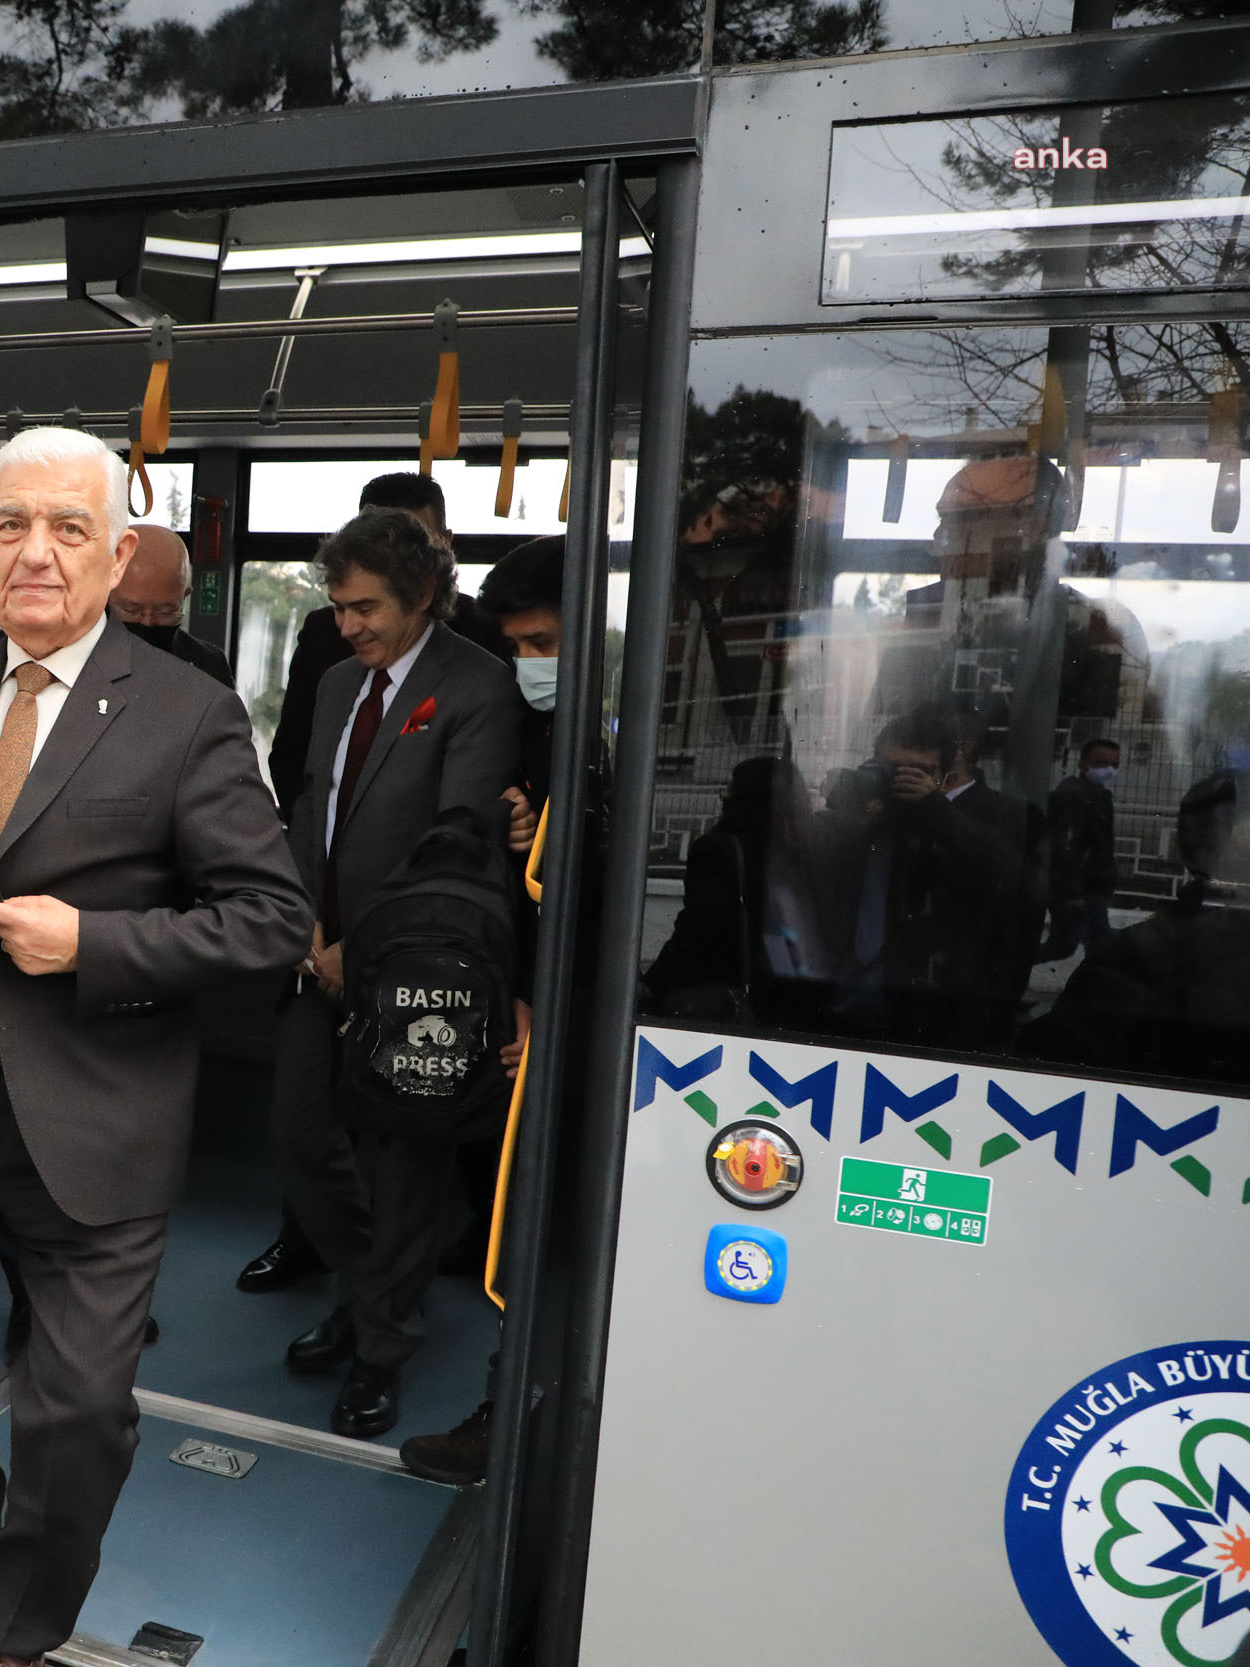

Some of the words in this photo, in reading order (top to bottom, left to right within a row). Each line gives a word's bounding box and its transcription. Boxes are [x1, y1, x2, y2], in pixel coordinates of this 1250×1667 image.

[395, 986, 472, 1009] BASIN
[393, 1055, 469, 1079] PRESS
[841, 1204, 847, 1213] 1
[876, 1209, 884, 1219] 2
[913, 1216, 921, 1225] 3
[950, 1221, 959, 1231] 4
[1021, 1465, 1062, 1512] T.C.
[1045, 1371, 1156, 1457] MUĞLA
